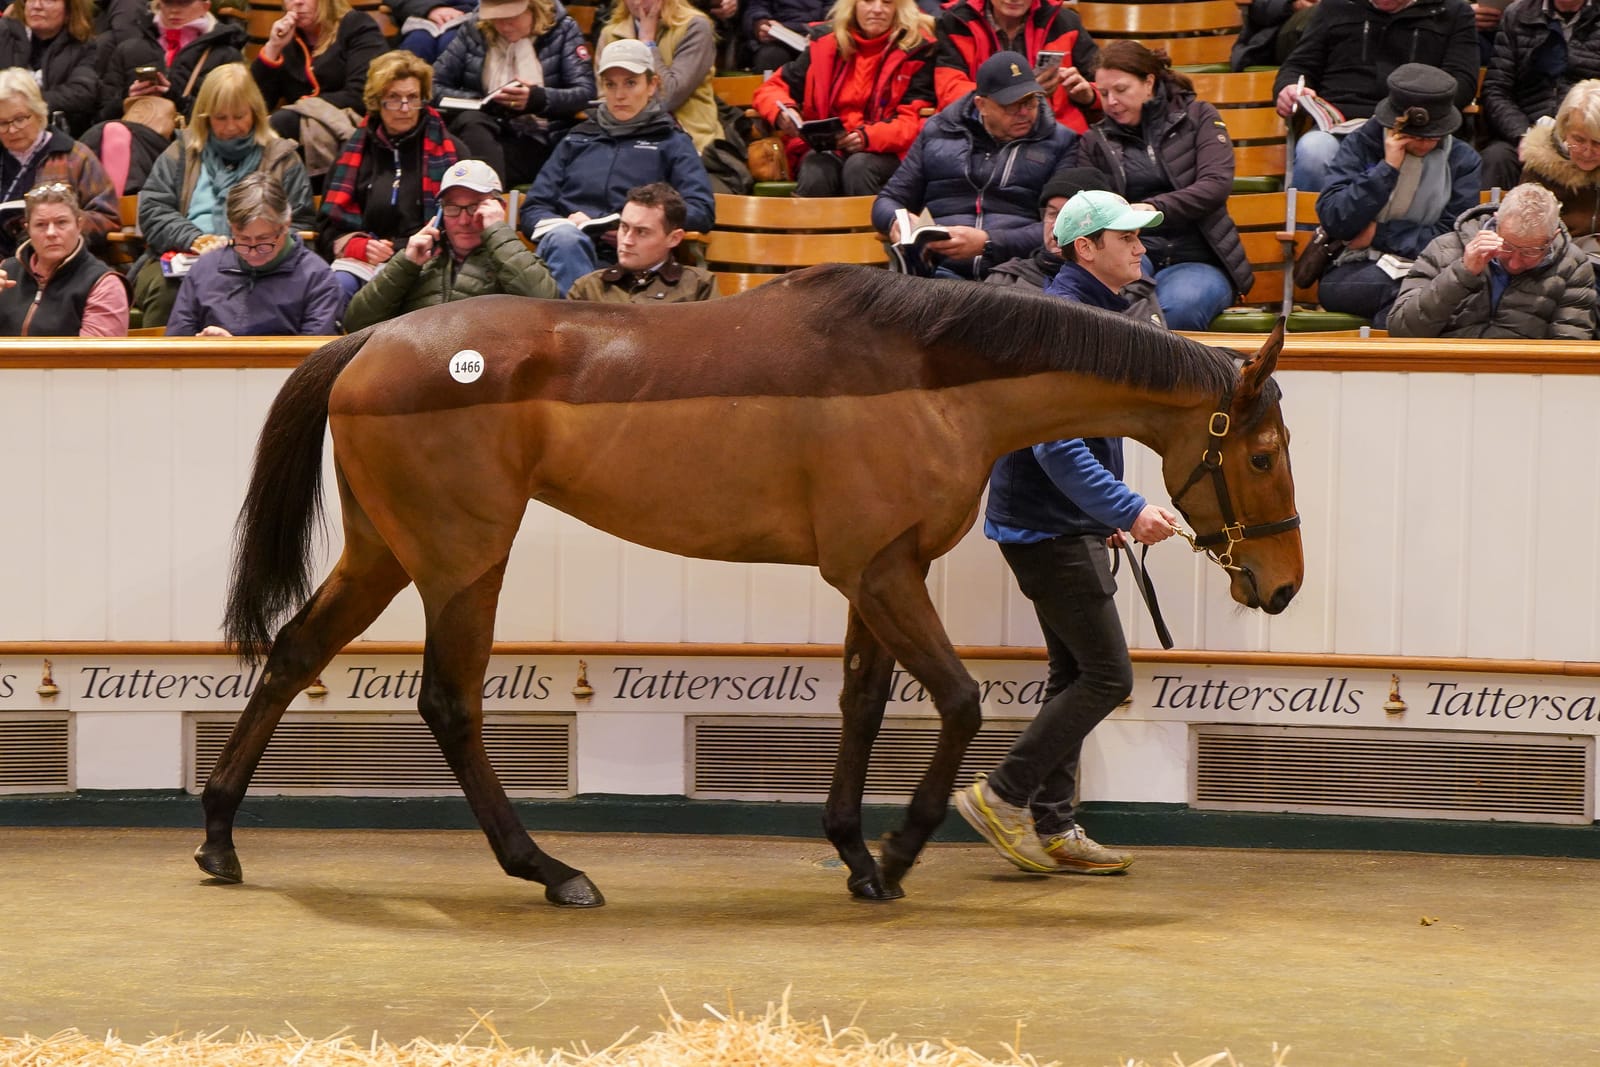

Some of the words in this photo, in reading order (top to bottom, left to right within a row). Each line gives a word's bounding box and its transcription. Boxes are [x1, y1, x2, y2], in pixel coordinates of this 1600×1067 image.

[455, 361, 480, 373] 1466
[80, 664, 257, 699] Tattersal
[347, 664, 553, 700] Tattalls
[612, 665, 820, 701] Tattersalls
[1151, 676, 1364, 714] Tattersalls
[1426, 682, 1600, 721] Tattersa
